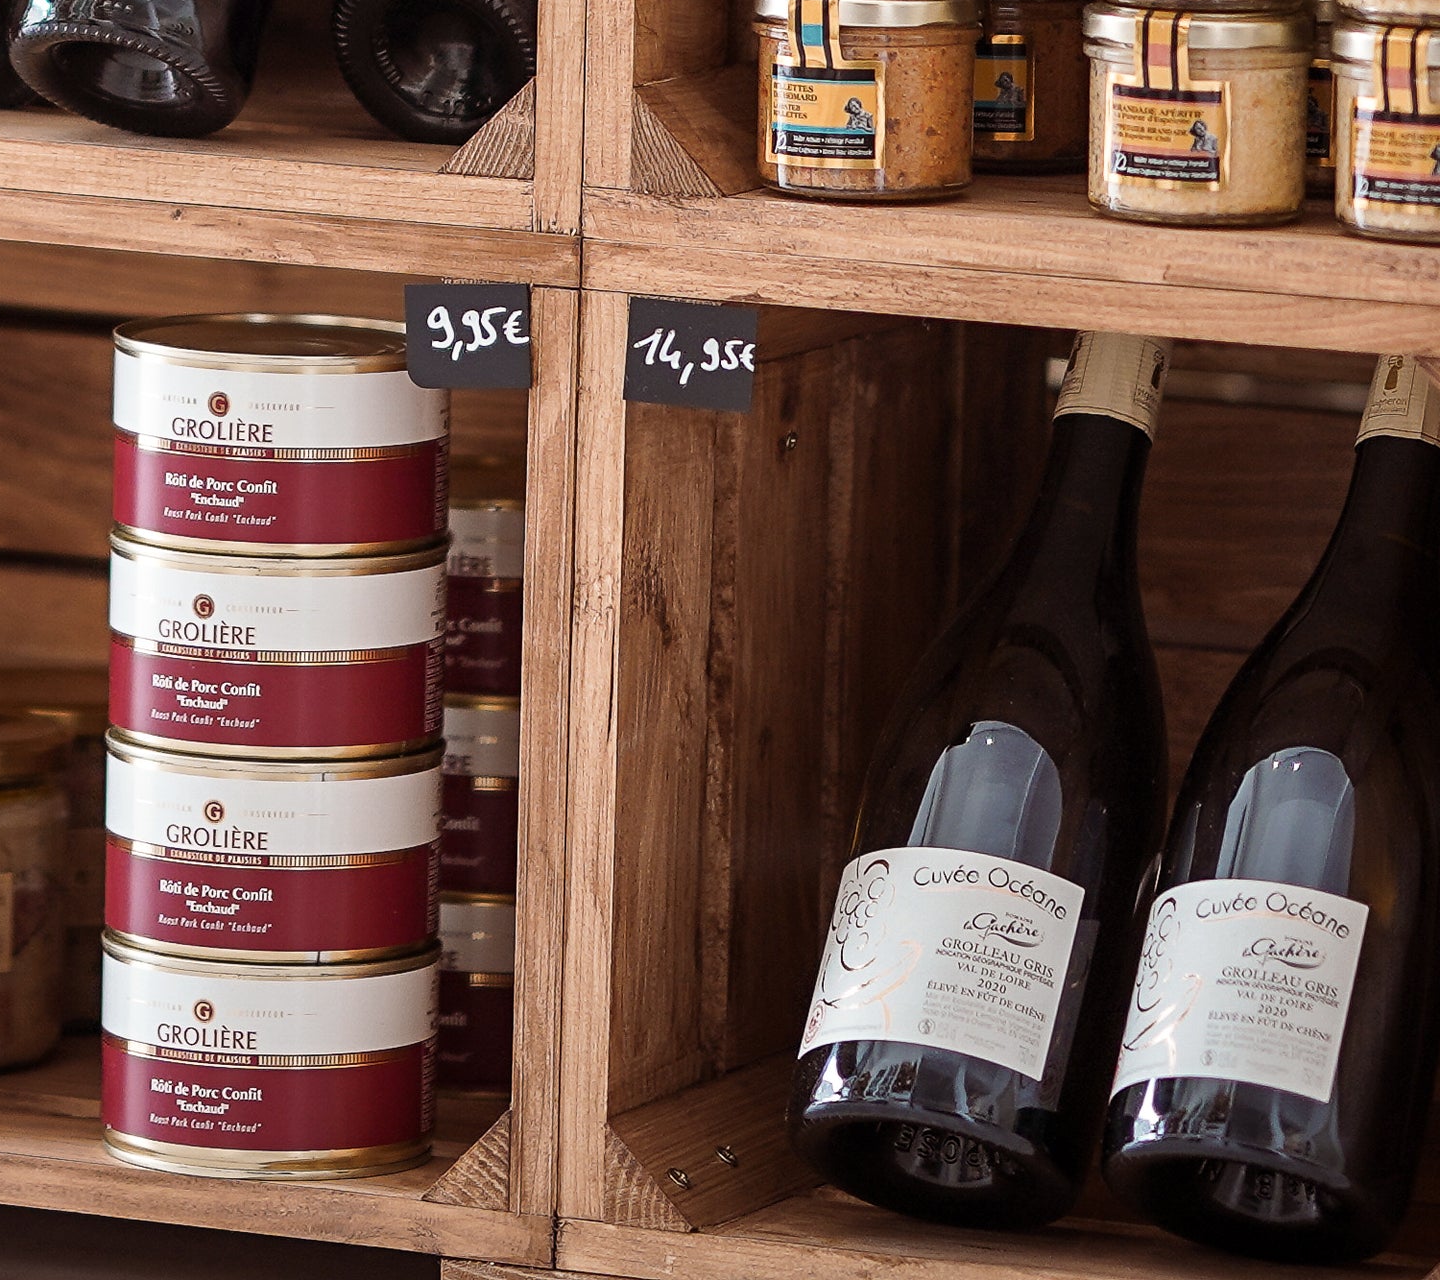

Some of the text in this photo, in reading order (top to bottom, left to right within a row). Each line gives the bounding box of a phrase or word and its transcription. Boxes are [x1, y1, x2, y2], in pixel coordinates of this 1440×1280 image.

[426, 305, 530, 362] 9,95€
[633, 328, 756, 386] 14,95€
[171, 417, 274, 444] GROLIÈRE
[165, 472, 277, 495] Rôti de Porc Confit
[158, 618, 256, 645] GROLIÈRE
[166, 824, 269, 851] GROLIÈRE
[913, 865, 1067, 921] Cuvée Océane
[941, 936, 1054, 978] GROLLEAU GRIS
[977, 977, 1008, 995] 2020
[1000, 971, 1032, 991] LOIRE
[157, 1023, 258, 1051] GROLIÈRE
